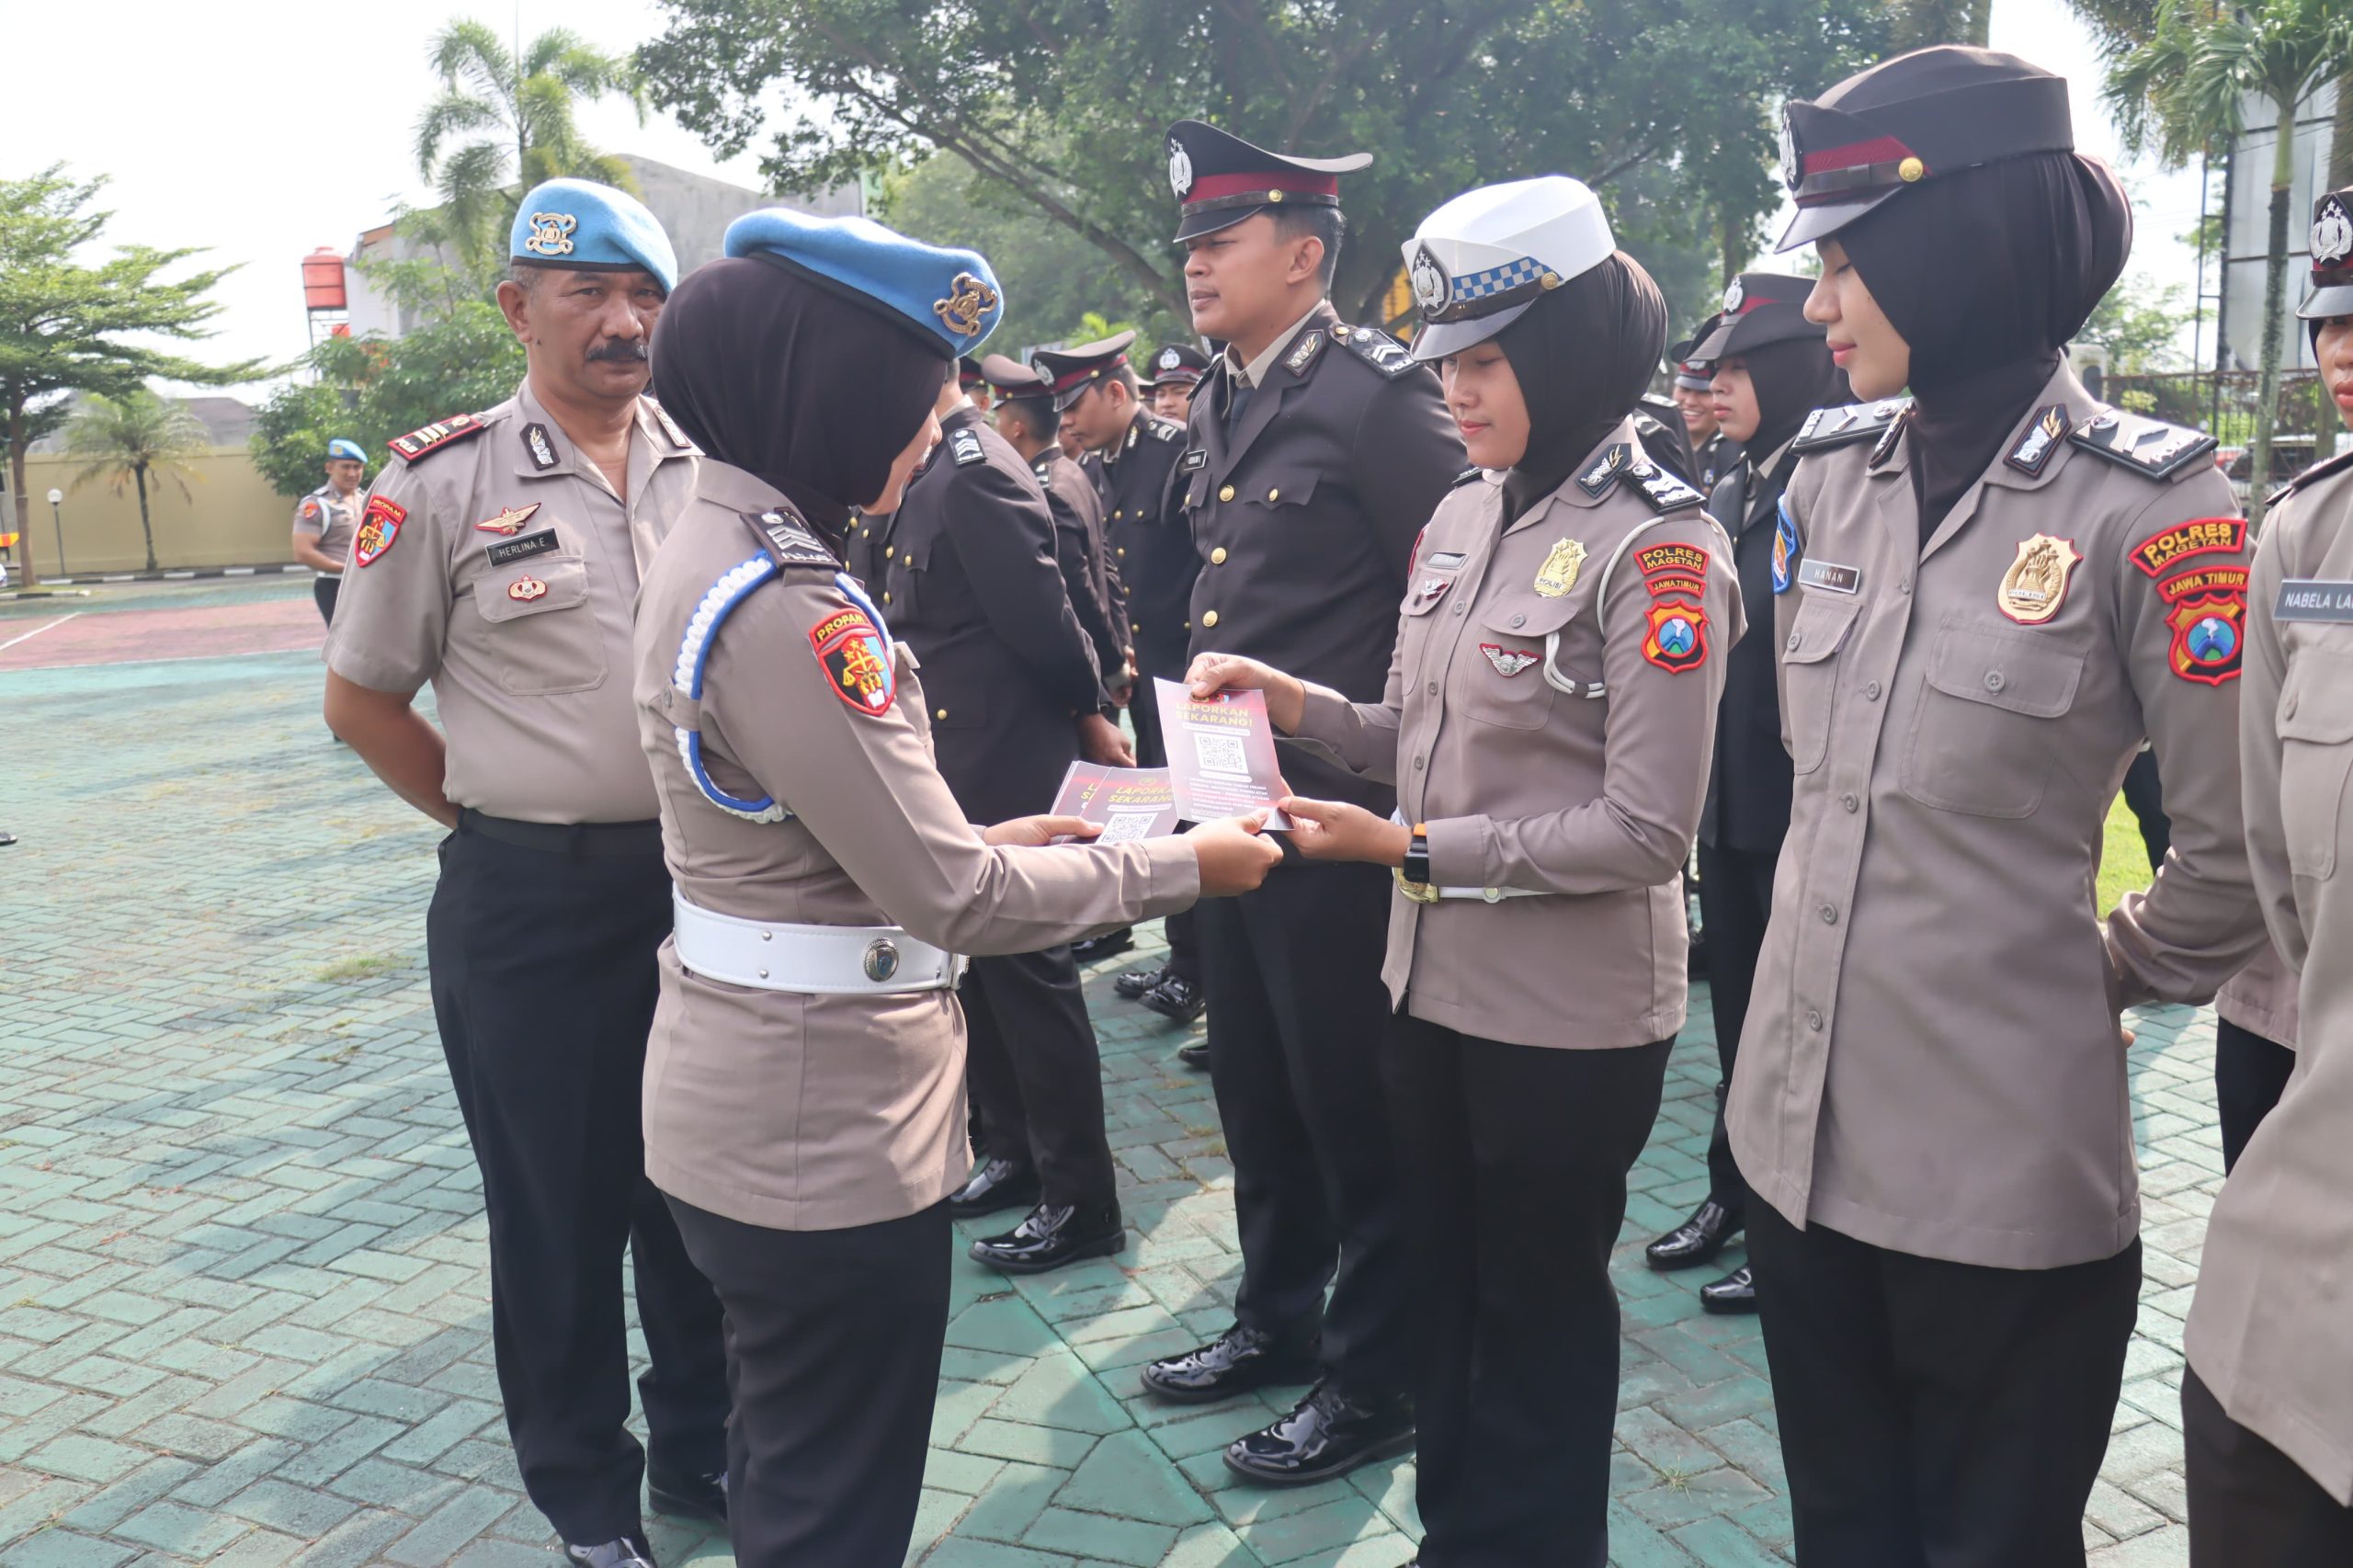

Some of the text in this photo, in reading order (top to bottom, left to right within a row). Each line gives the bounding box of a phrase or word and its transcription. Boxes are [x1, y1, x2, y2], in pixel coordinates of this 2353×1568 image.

[499, 537, 546, 558] HERLINA E
[2143, 523, 2232, 561] POLRES
[1643, 547, 1703, 562] POLRES
[2150, 537, 2232, 568] MAGETAN
[1646, 556, 1702, 570] MAGETAN
[1814, 568, 1844, 583] HANAN
[2168, 572, 2245, 595] JAWA TIMUR
[1654, 579, 1700, 591] JAWA TIMUR
[2285, 591, 2353, 609] NABELA LA
[816, 613, 864, 641] PROPAM
[1176, 702, 1248, 717] LAPORKAN
[1176, 710, 1253, 727] SEKARANG!
[1116, 786, 1173, 795] LAPORKA
